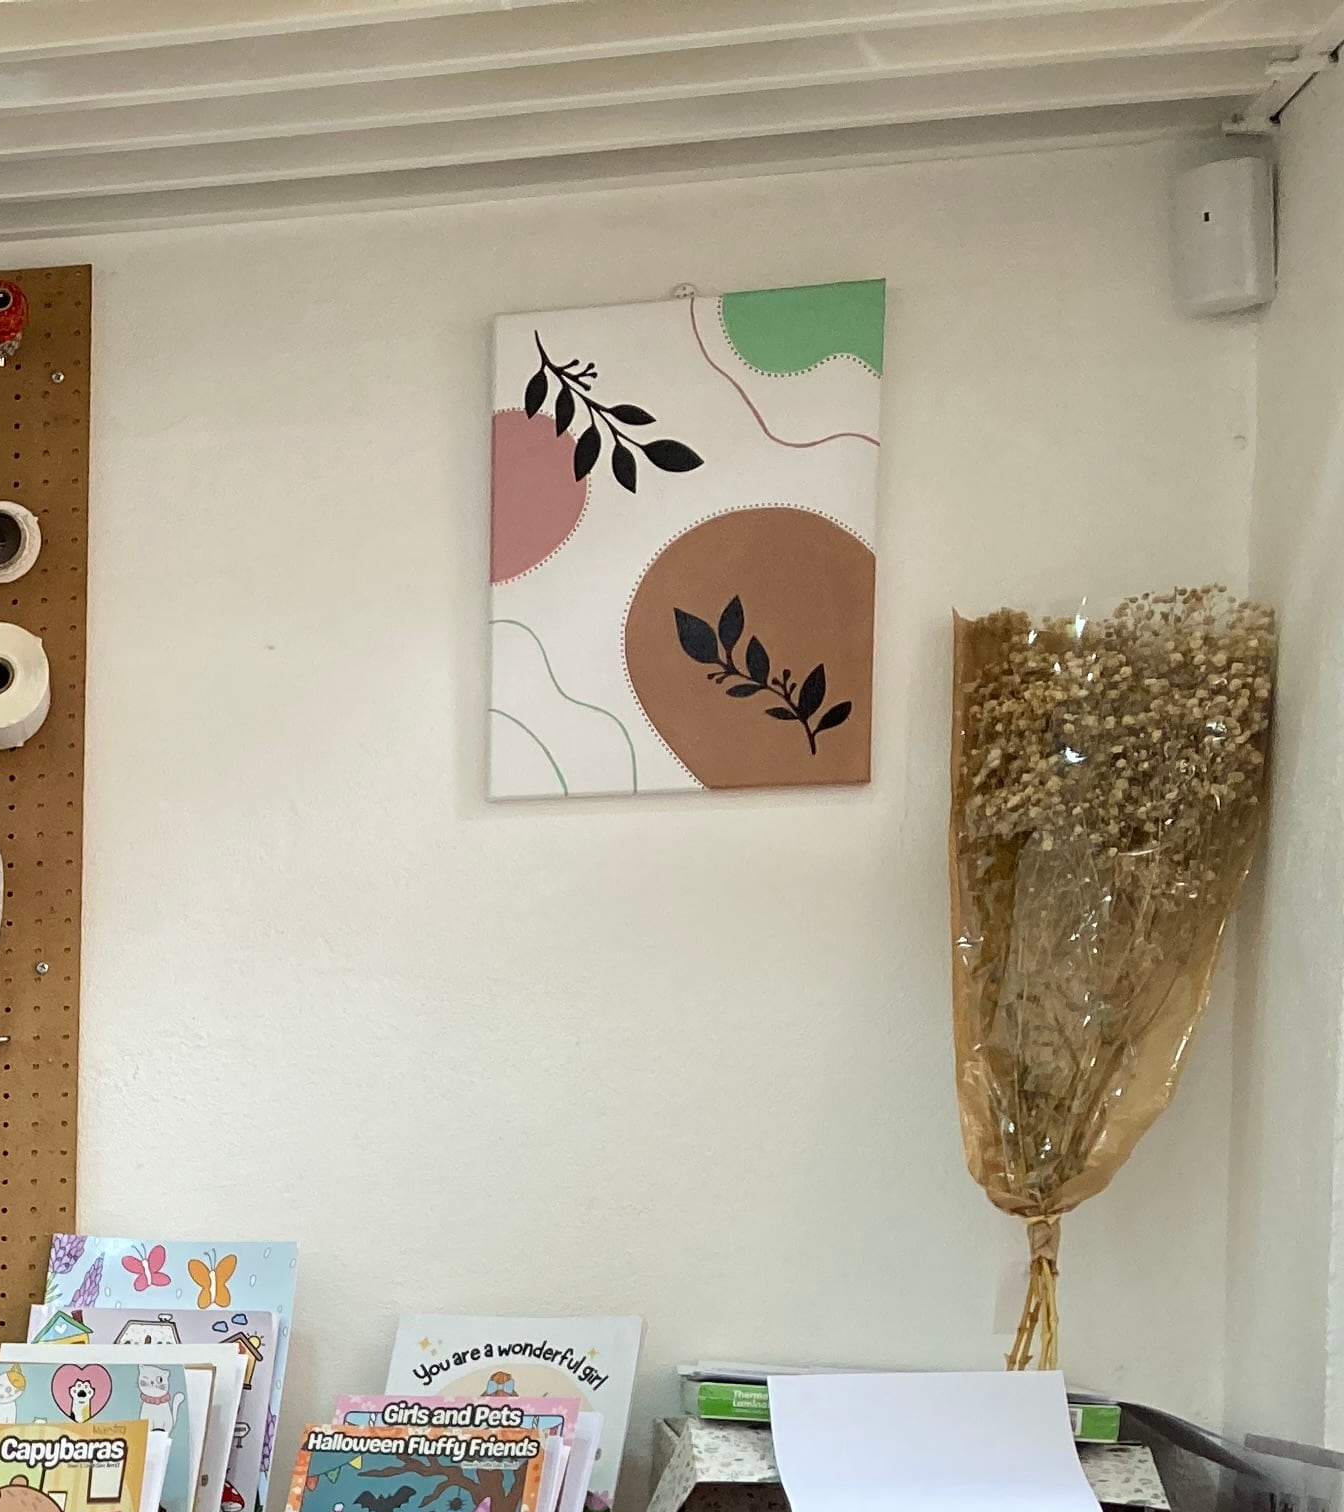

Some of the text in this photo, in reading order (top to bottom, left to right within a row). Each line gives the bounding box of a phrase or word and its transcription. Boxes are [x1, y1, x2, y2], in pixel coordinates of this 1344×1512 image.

[413, 1341, 609, 1390] You are a wonderful girl
[733, 1390, 768, 1400] Therma
[384, 1405, 521, 1426] Girls and Pets
[0, 1437, 125, 1468] Capybaras
[308, 1433, 538, 1461] Halloween Fluffy Friends
